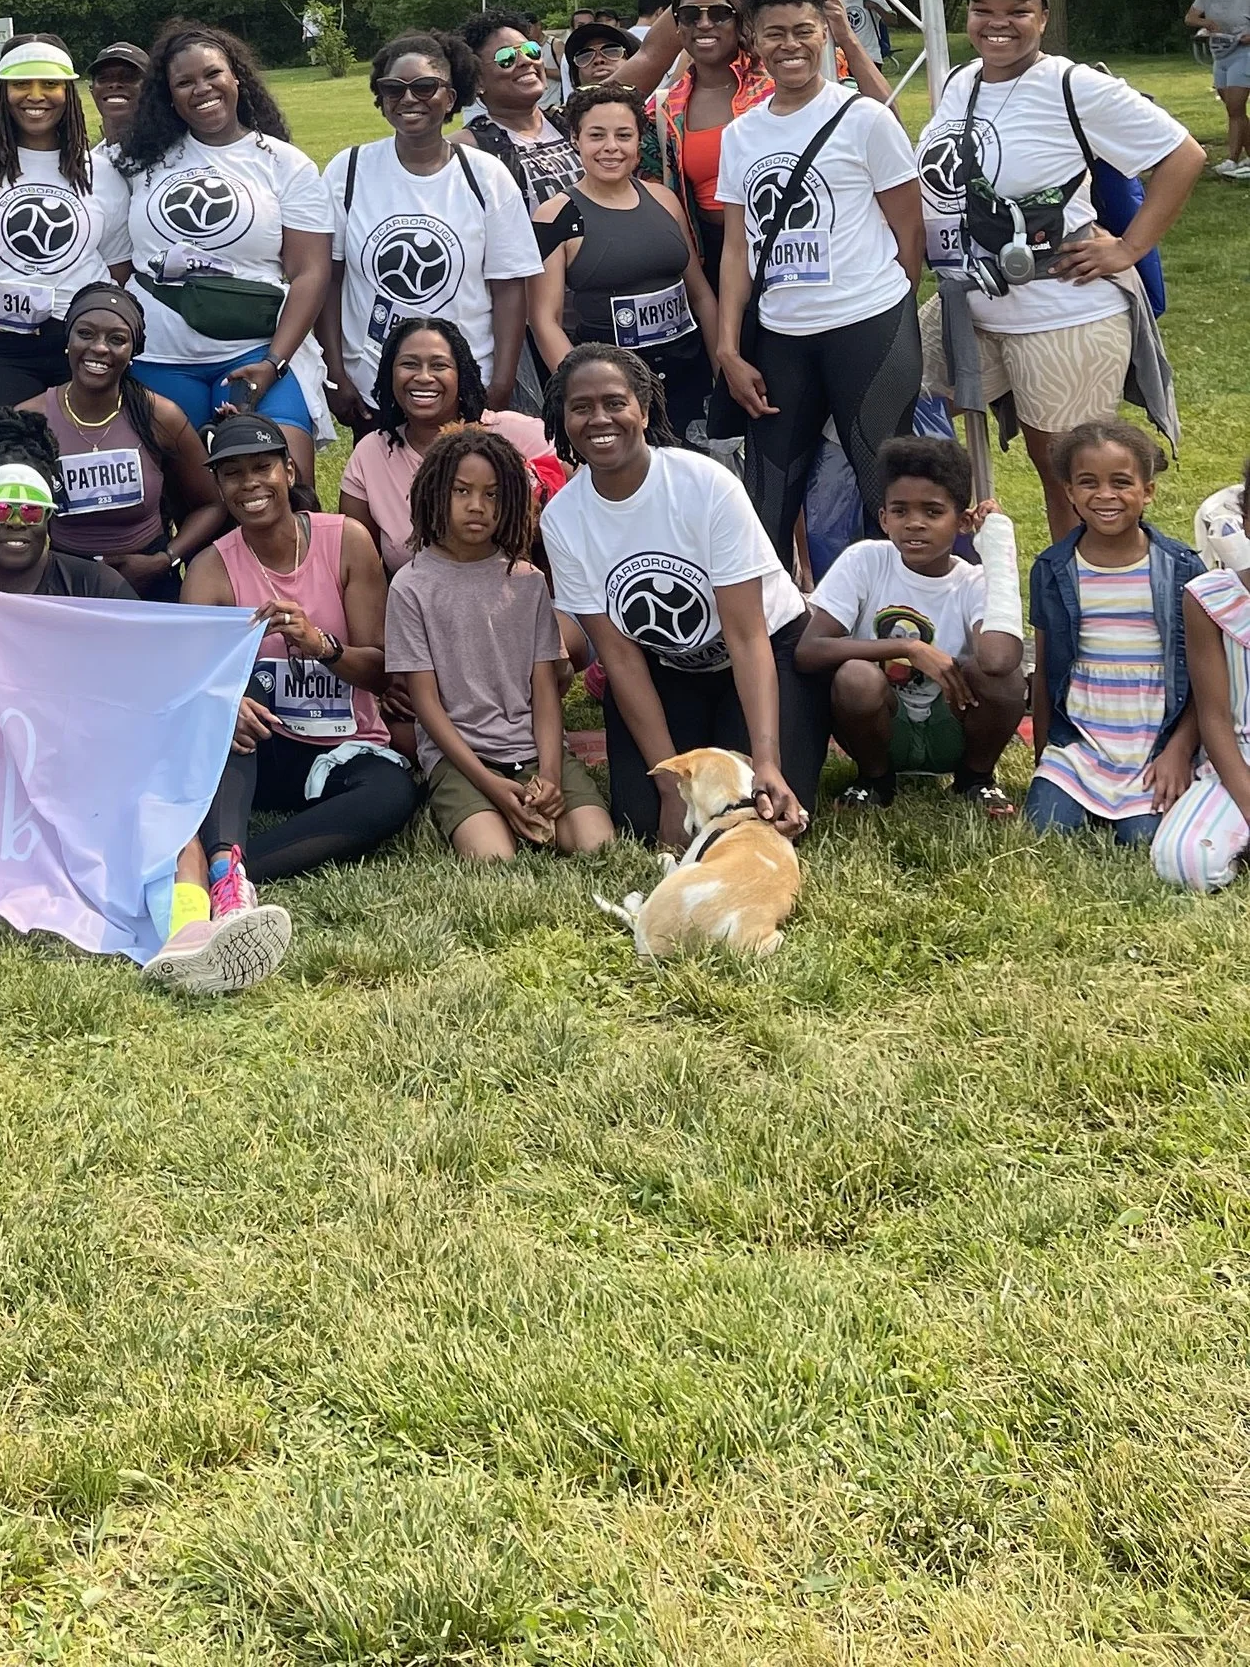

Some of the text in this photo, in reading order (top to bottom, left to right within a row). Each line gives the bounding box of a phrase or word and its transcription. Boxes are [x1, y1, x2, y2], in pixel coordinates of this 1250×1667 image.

[0, 186, 83, 213] SCARBOROUGH
[371, 218, 457, 248] SCARBOROUGH
[3, 293, 31, 315] 314
[66, 461, 138, 491] PATRICE
[608, 557, 703, 599] SCARBOROUGH
[284, 674, 342, 699] NICOLE
[309, 710, 323, 718] 152
[334, 725, 347, 733] 152
